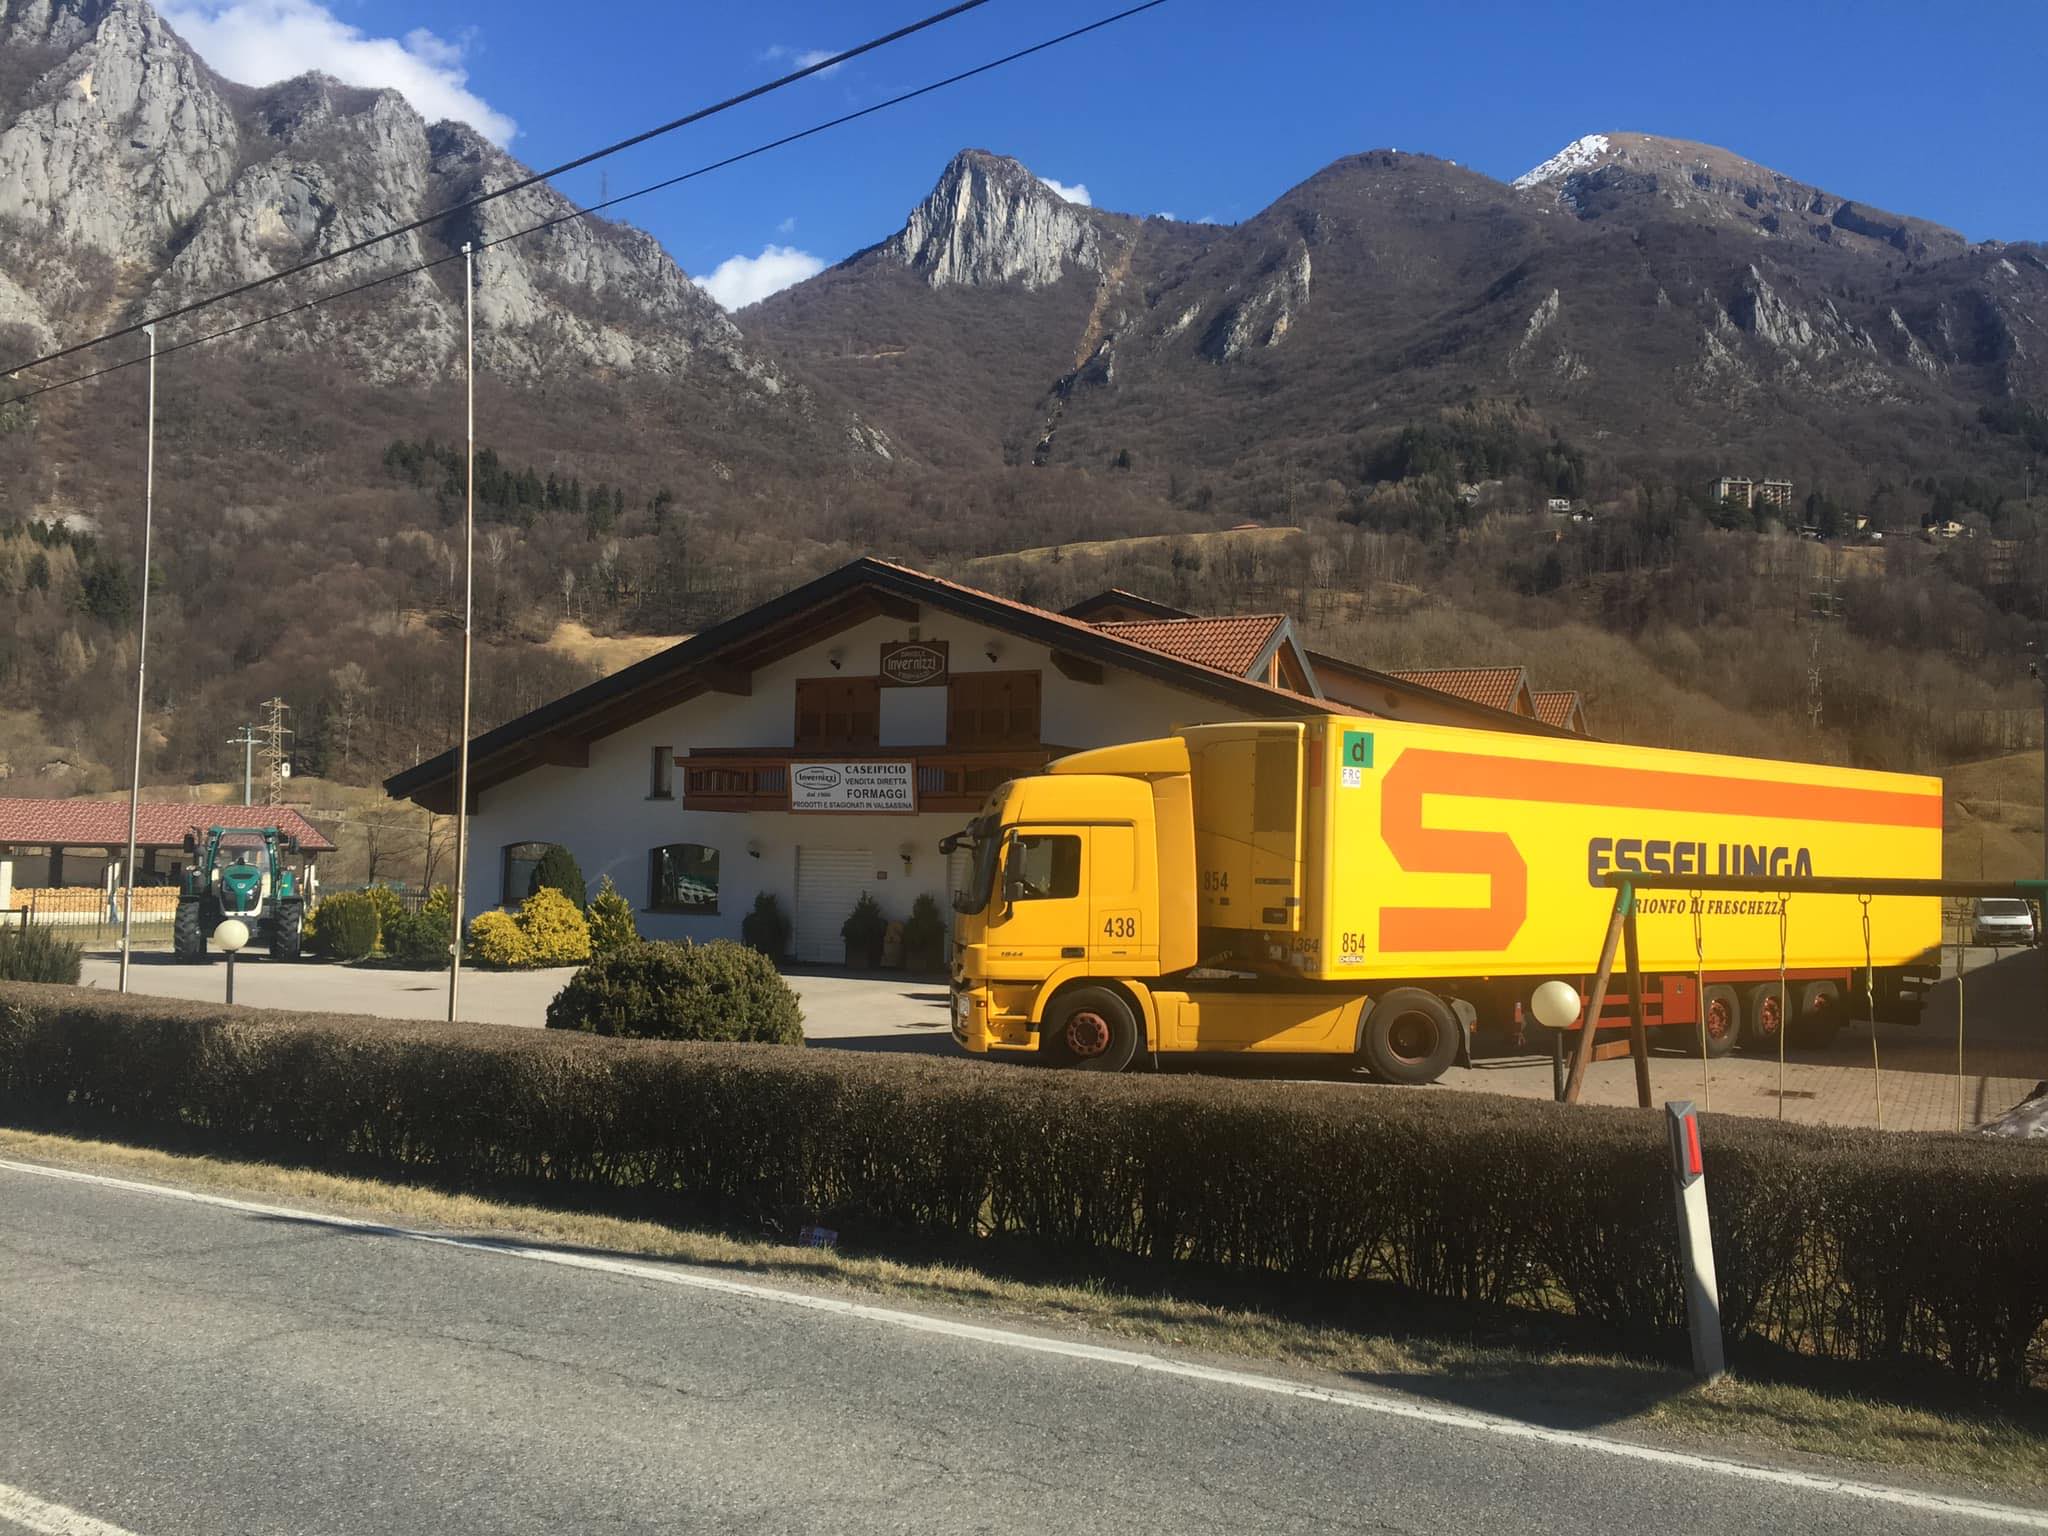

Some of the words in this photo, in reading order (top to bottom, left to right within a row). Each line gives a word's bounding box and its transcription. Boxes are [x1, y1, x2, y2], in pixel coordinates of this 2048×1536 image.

[1352, 737, 1365, 762] d
[845, 765, 906, 774] CASEIFICIO
[847, 789, 906, 799] FORMAGGI
[793, 801, 823, 809] PRODOTTI
[829, 801, 864, 809] STAGIONATI
[873, 801, 913, 809] VALSASSINA
[1204, 872, 1228, 891] 854
[1708, 899, 1786, 915] FRESCHEZZA
[1104, 917, 1135, 938] 438
[1342, 932, 1365, 953] 854
